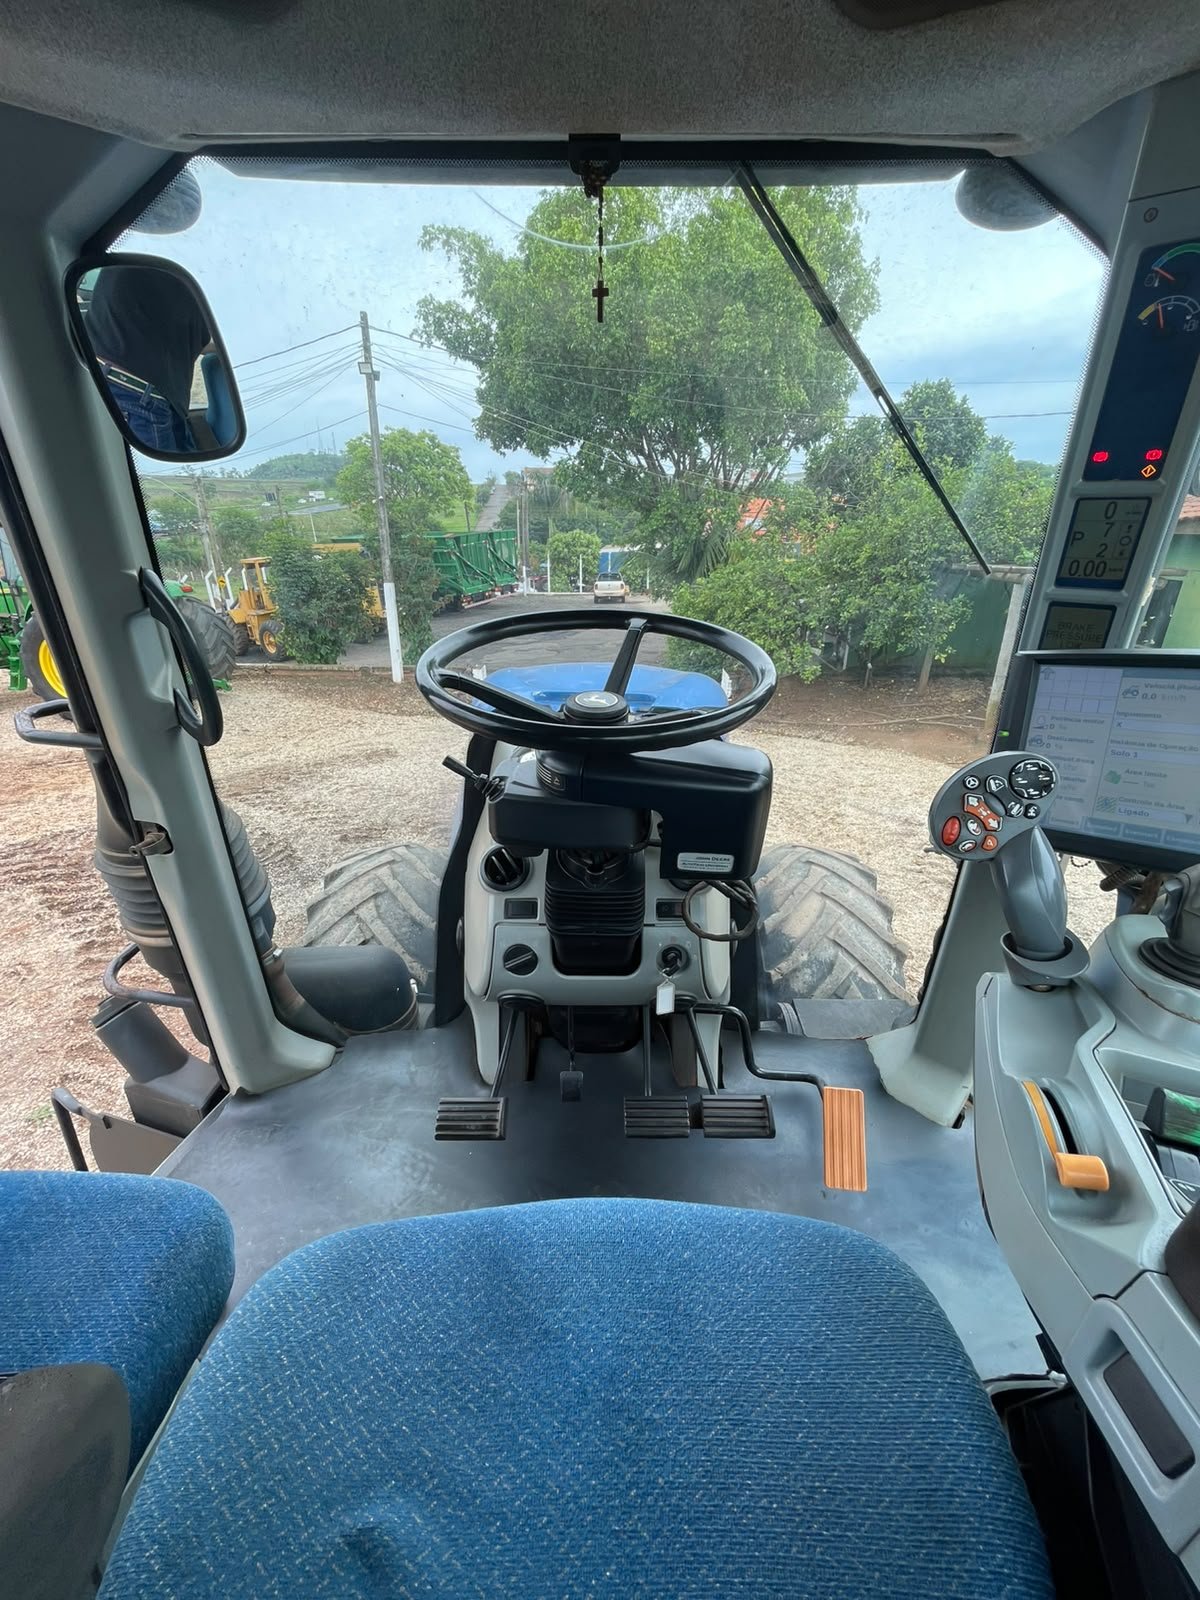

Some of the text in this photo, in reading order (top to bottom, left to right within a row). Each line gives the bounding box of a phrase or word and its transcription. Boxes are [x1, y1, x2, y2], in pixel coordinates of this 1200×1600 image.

[1104, 501, 1117, 520] 0
[1103, 522, 1115, 538] 7
[1070, 531, 1085, 546] P
[1096, 543, 1108, 559] 2
[1068, 559, 1108, 578] 0.00
[1056, 621, 1097, 633] BRAKE
[1046, 630, 1104, 643] PRESSURE
[1118, 807, 1150, 818] Ligado
